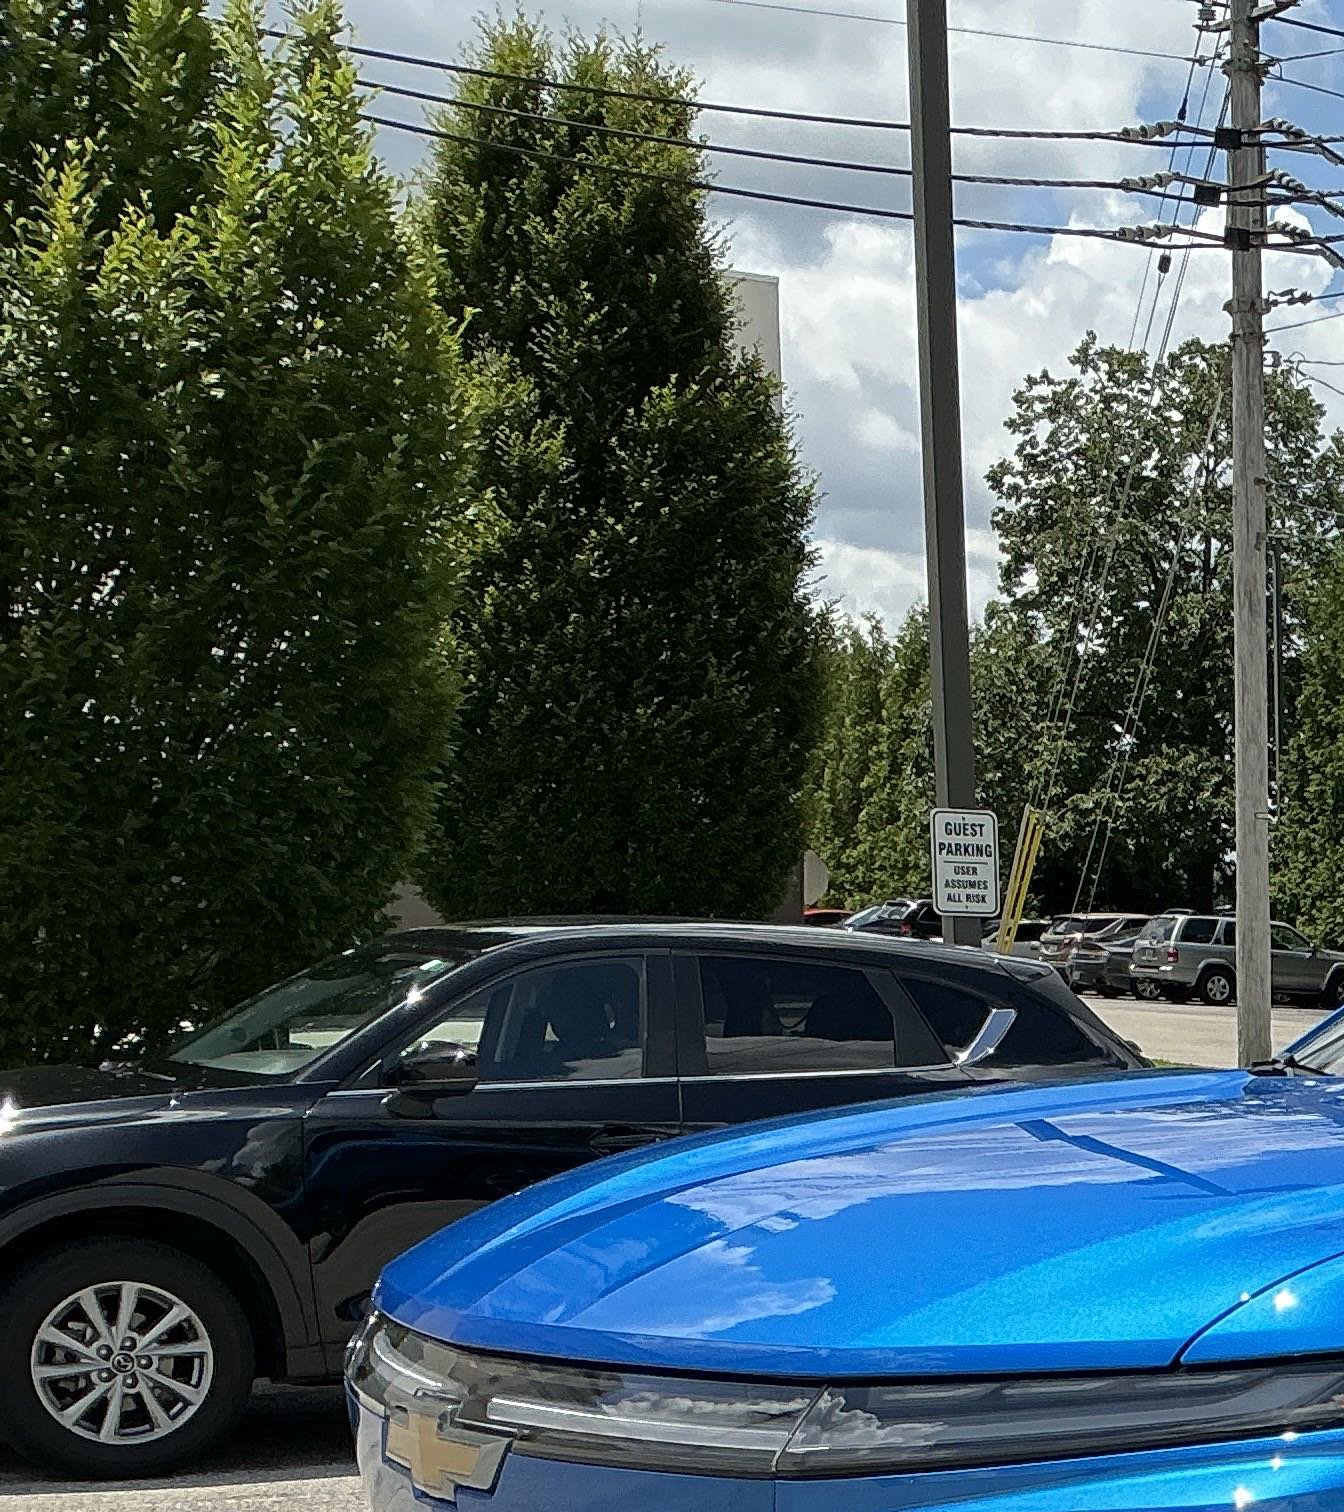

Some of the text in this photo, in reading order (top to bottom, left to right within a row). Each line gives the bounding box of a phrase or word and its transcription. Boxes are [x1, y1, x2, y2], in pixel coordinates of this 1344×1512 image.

[944, 821, 986, 838] GUEST
[938, 841, 993, 858] PARKING
[953, 865, 978, 876] USER
[944, 878, 989, 891] ASSUMES
[946, 892, 987, 904] ALL RISK
